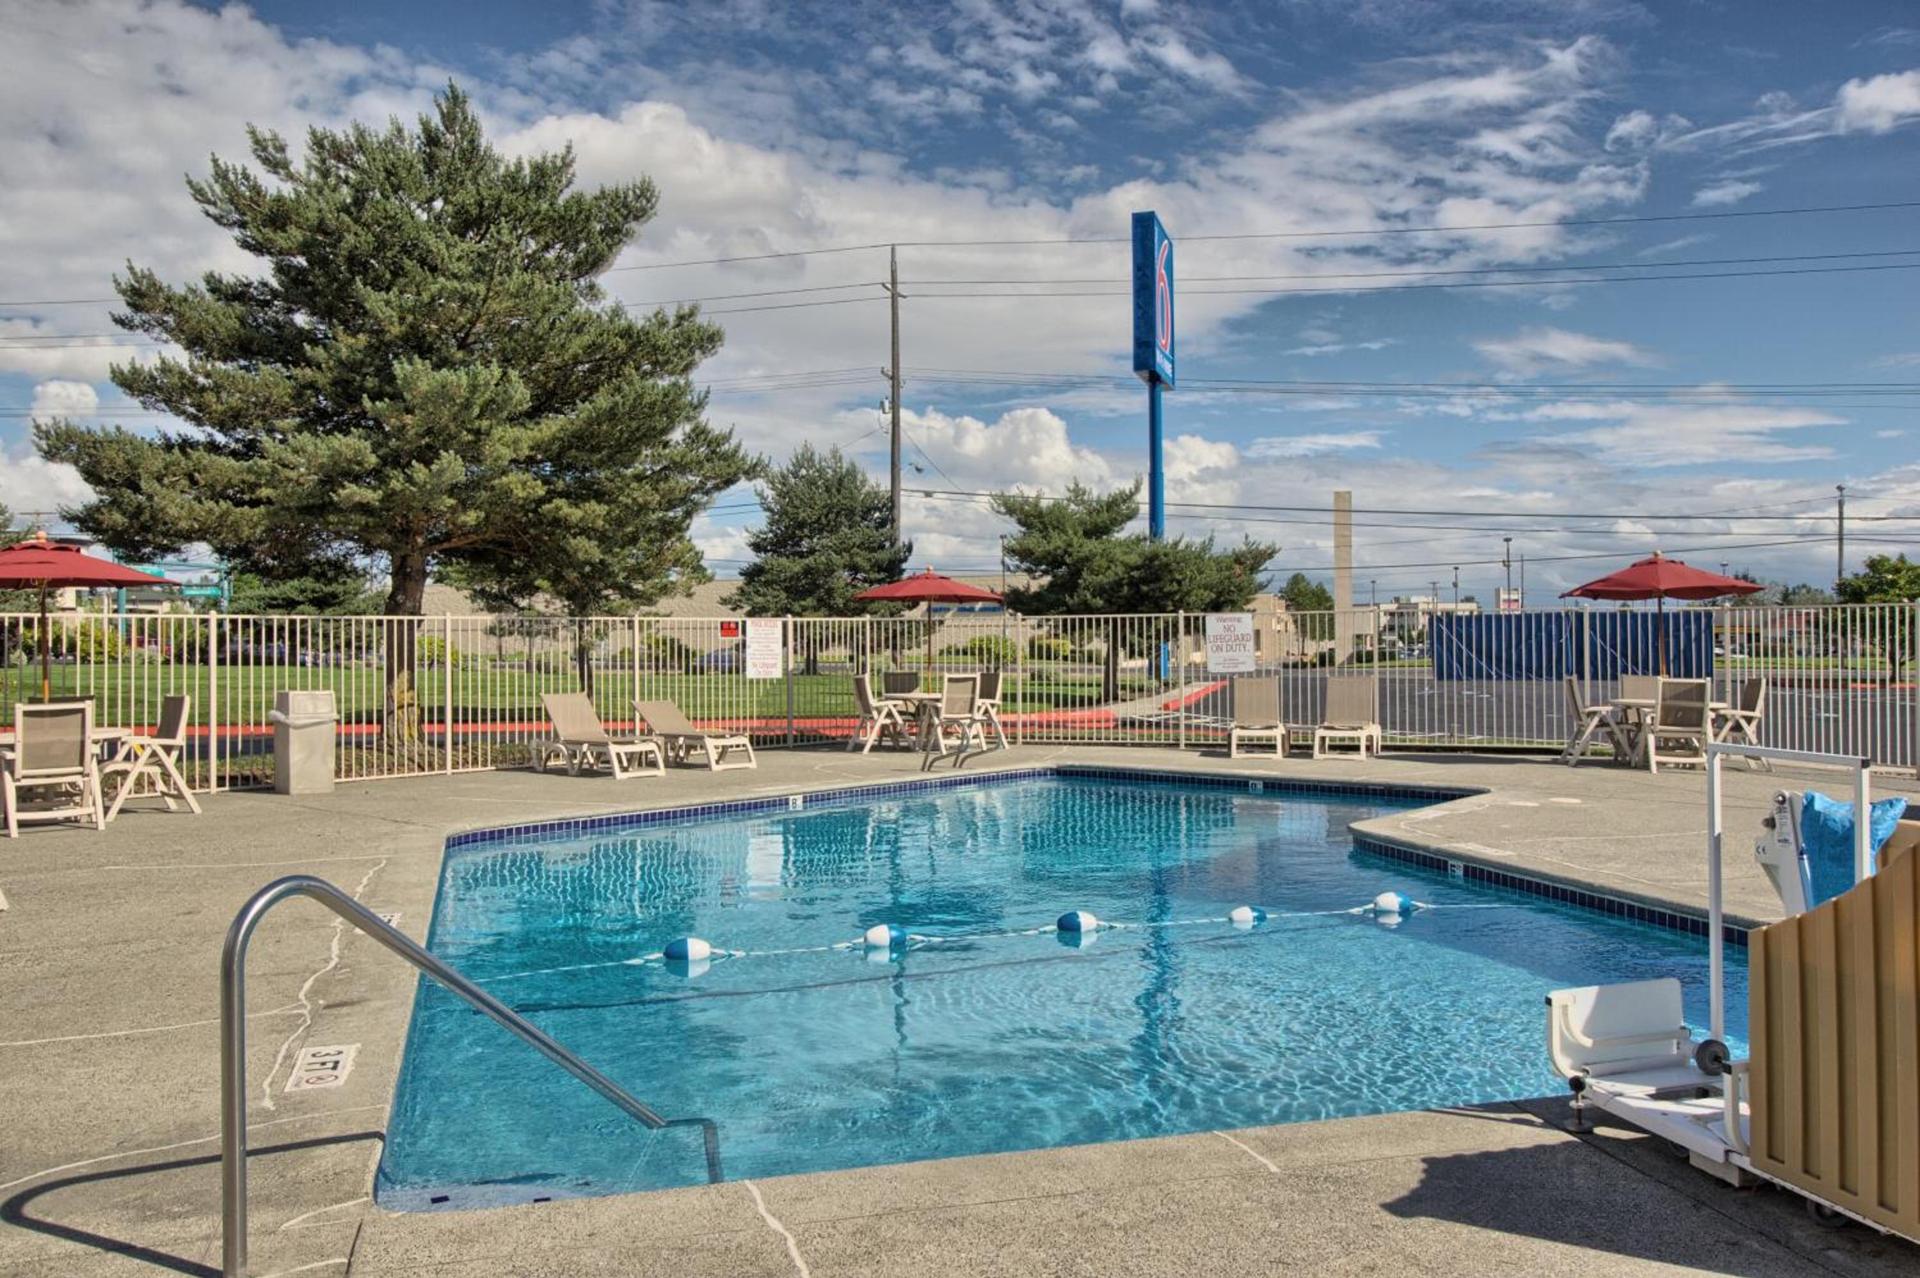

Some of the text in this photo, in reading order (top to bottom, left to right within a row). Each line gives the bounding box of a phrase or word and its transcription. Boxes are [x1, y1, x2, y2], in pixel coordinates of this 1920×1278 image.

[1156, 240, 1171, 351] 6
[1223, 624, 1236, 633] NO
[1208, 633, 1252, 644] LIFEGUARD
[1210, 644, 1223, 654] ON
